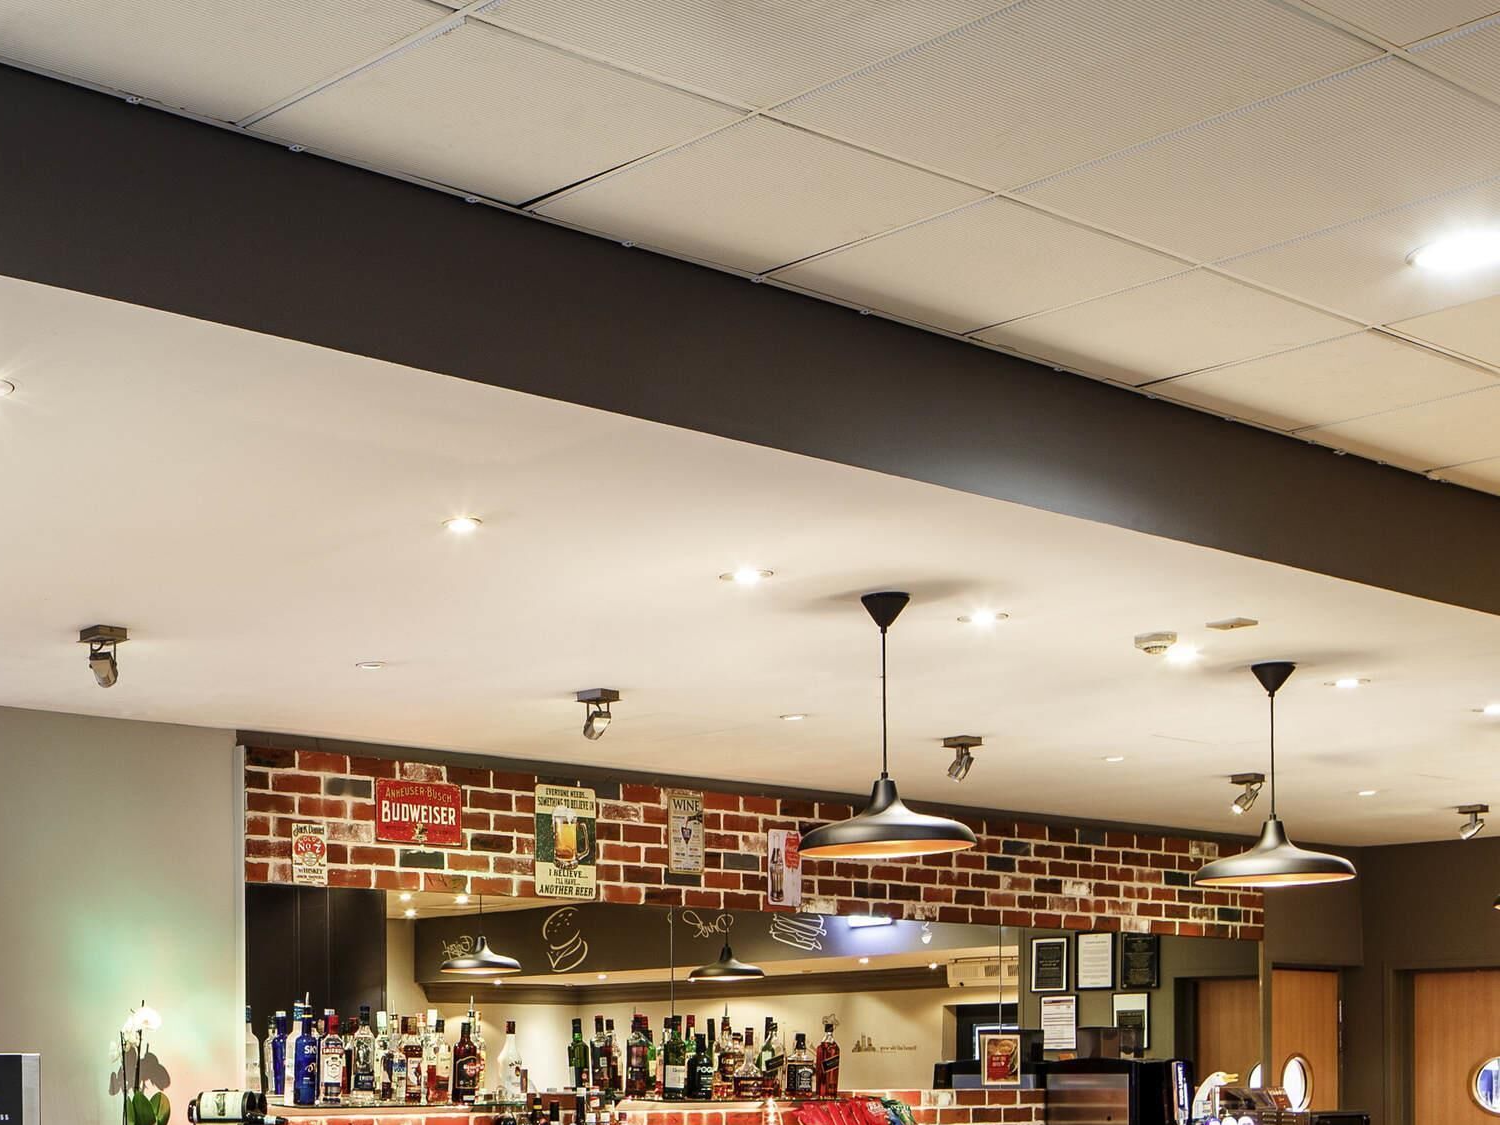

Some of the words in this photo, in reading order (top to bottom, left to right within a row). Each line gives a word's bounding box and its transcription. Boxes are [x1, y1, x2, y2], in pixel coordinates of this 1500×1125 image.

[545, 787, 569, 797] EVERYONE
[672, 798, 700, 812] WINE
[381, 800, 456, 825] BUDWEISER
[538, 884, 573, 896] ANOTHER
[575, 886, 594, 897] BEER
